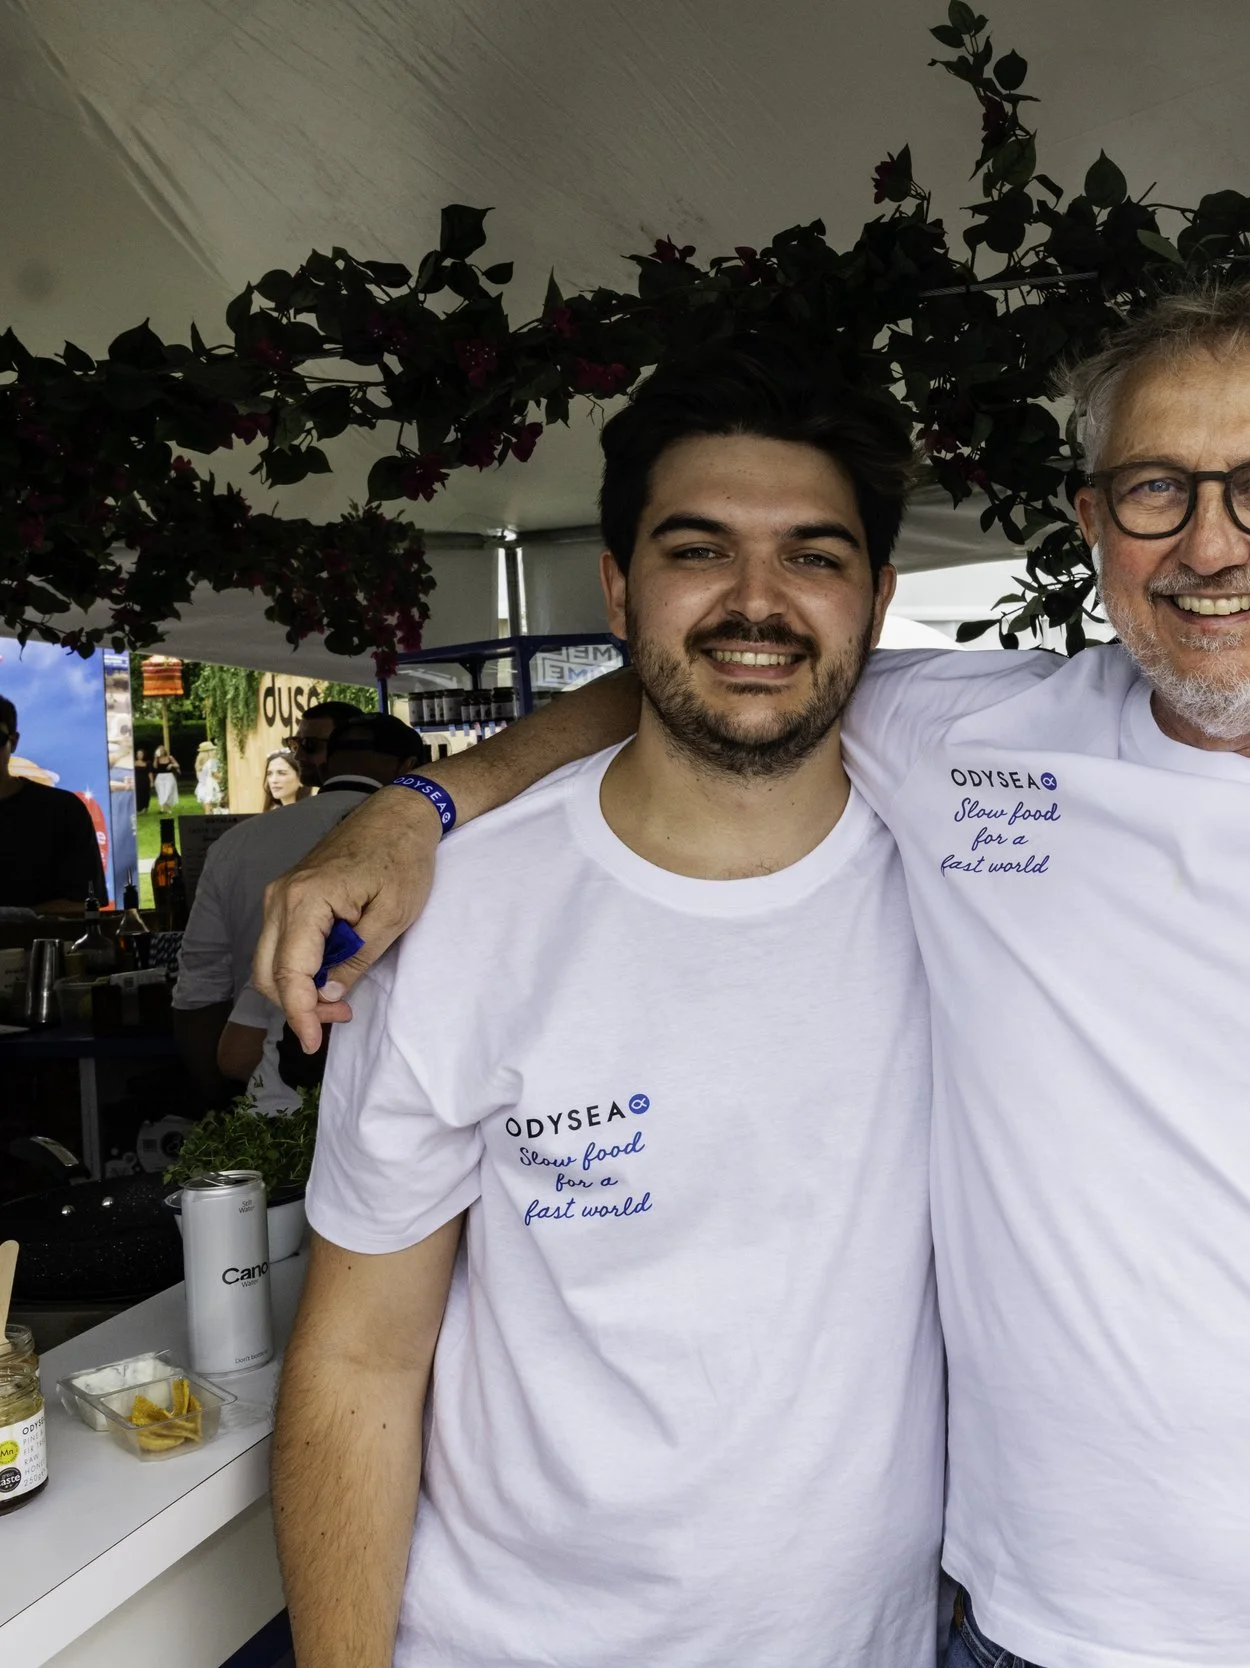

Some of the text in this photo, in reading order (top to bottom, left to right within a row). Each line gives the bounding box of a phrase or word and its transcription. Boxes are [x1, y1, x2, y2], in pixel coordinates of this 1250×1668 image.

[951, 768, 1041, 791] ODYSEA
[393, 777, 447, 813] ODYSEA
[954, 797, 1061, 826] Slow food
[971, 826, 1029, 851] for a
[940, 854, 1050, 878] fast world
[505, 1100, 627, 1139] ODYSEA
[519, 1131, 646, 1170] Slow food
[555, 1172, 619, 1192] for a
[524, 1192, 653, 1226] fast world
[222, 1261, 269, 1285] Cano
[0, 1474, 20, 1486] aste
